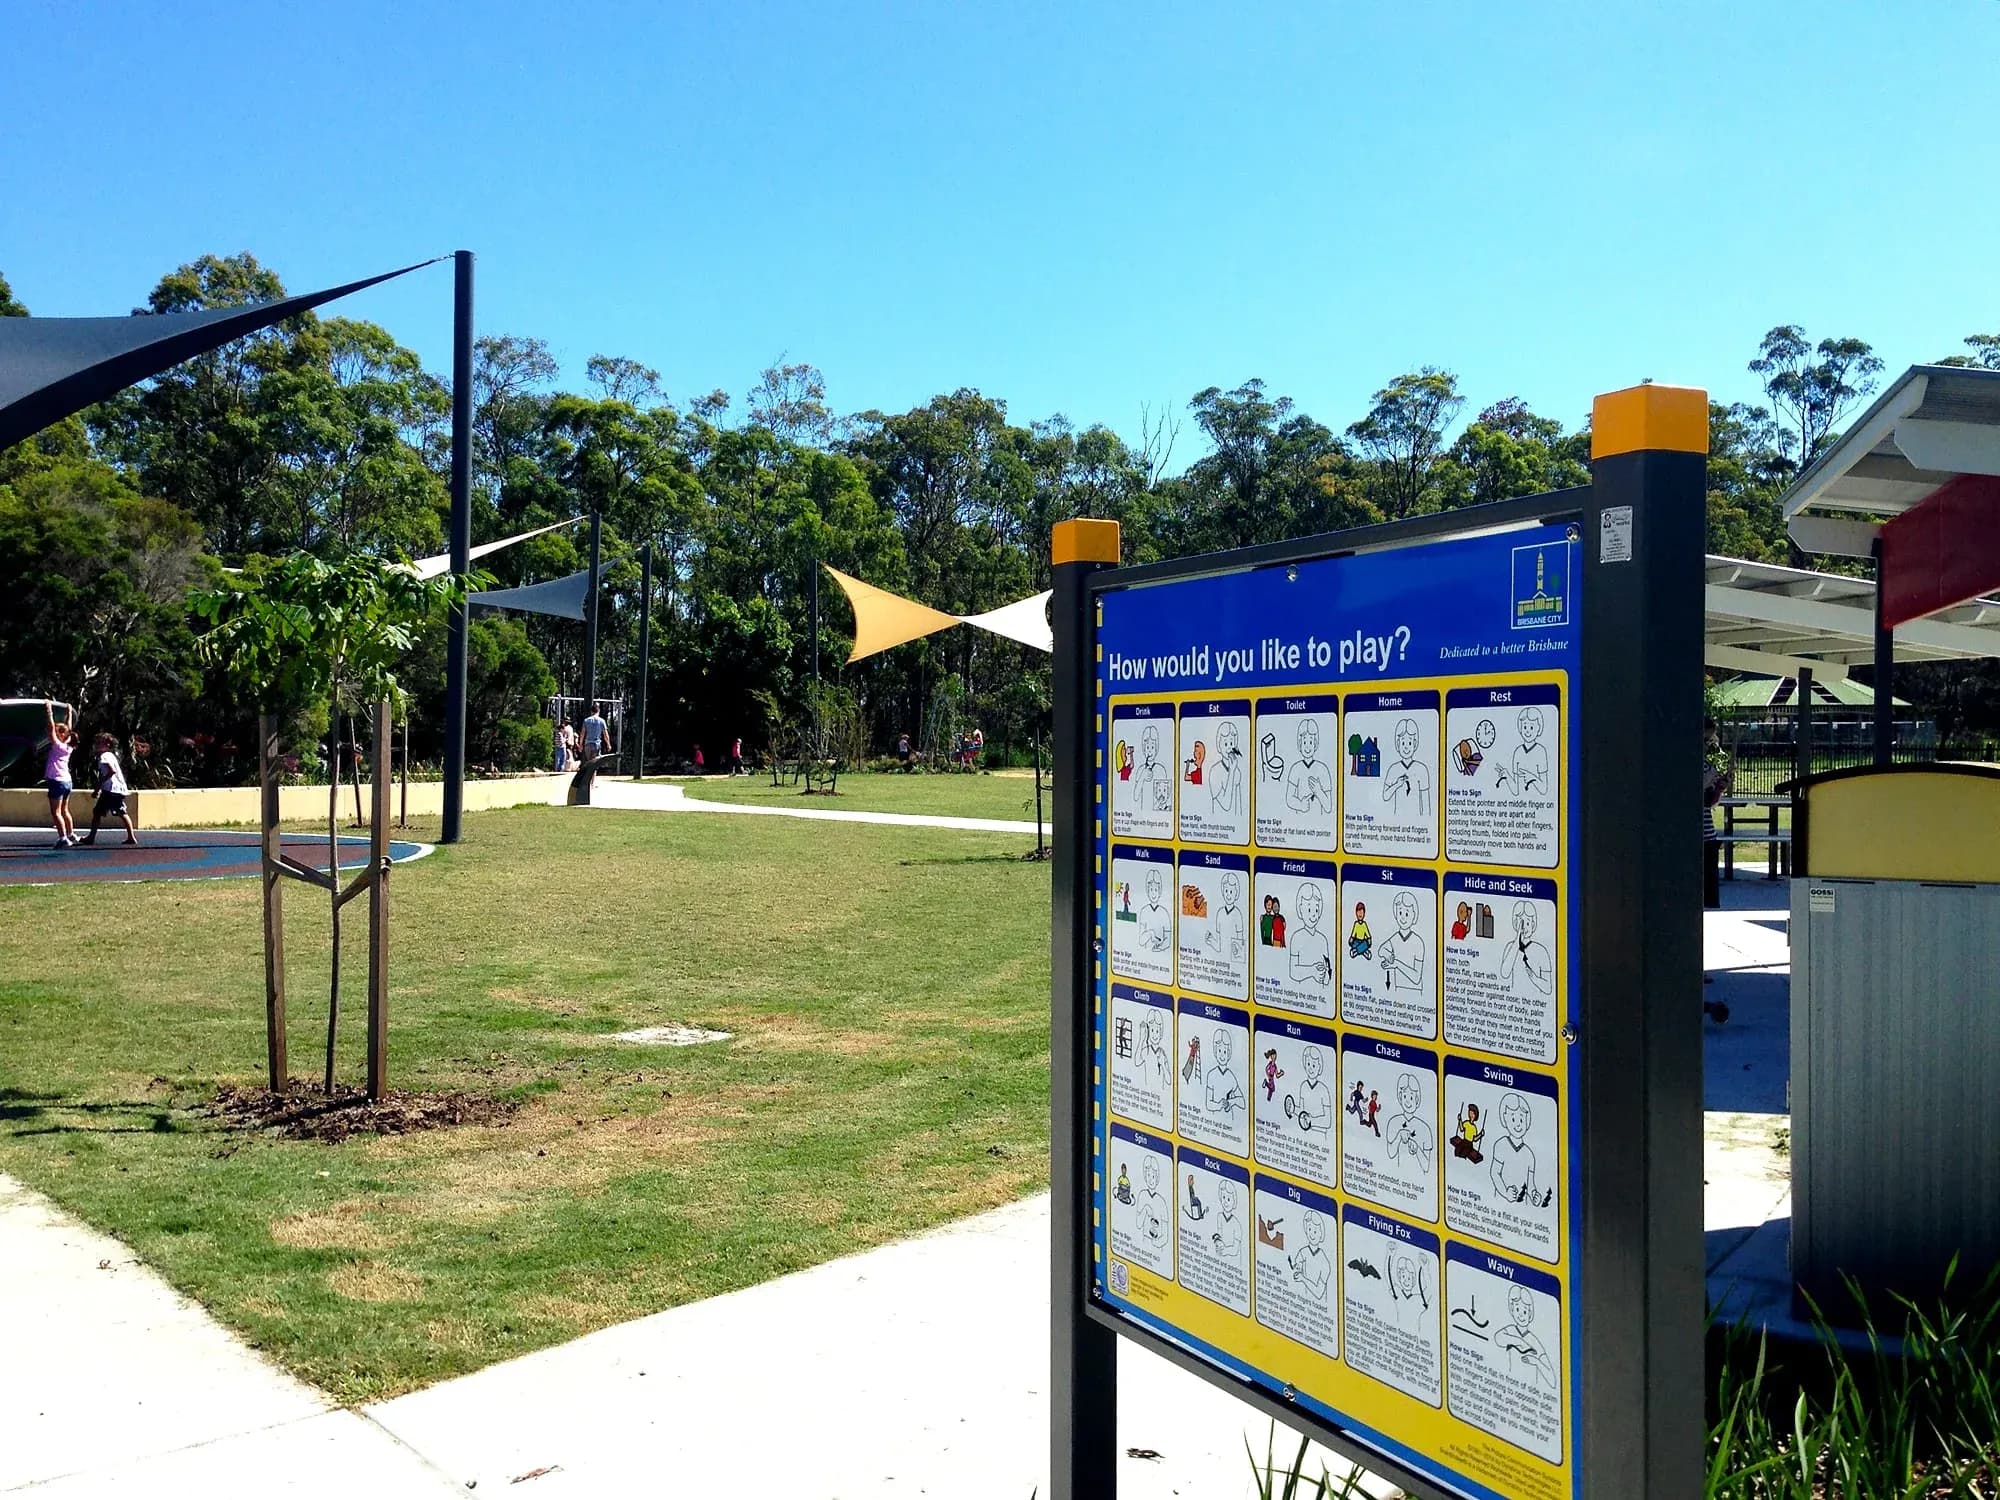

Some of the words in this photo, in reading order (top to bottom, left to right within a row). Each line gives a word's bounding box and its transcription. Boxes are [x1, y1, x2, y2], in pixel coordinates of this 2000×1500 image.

[1548, 614, 1562, 623] CITY
[1110, 653, 1147, 681] How
[1152, 645, 1209, 677] would
[1215, 649, 1254, 682] you
[1262, 638, 1300, 670] like
[1307, 636, 1331, 667] to
[1339, 626, 1411, 673] play?
[1440, 645, 1479, 660] Dedicated
[1482, 644, 1490, 656] to
[1493, 647, 1498, 655] a
[1500, 642, 1525, 654] better
[1528, 638, 1568, 652] Brisbane
[1379, 697, 1402, 706] Home
[1491, 692, 1511, 702] Rest
[1209, 704, 1219, 713] Eat
[1286, 700, 1305, 710] Toilet
[1136, 707, 1150, 715] Drink
[1469, 789, 1482, 798] Sign
[1528, 800, 1545, 810] finger
[1485, 809, 1497, 818] they
[1363, 815, 1374, 823] Sign
[1136, 849, 1149, 858] Walk
[1206, 855, 1220, 864] Sand
[1283, 862, 1305, 872] Friend
[1382, 870, 1392, 880] Sit
[1465, 877, 1486, 889] Hide
[1489, 880, 1505, 890] and
[1509, 881, 1532, 893] Seek
[1467, 949, 1479, 958] Sign
[1205, 1006, 1220, 1017] Slide
[1287, 1024, 1300, 1035] Run
[1376, 1044, 1400, 1058] Chase
[1484, 1067, 1513, 1086] Swing
[1135, 1133, 1147, 1144] Spin
[1205, 1158, 1220, 1171] Rock
[1289, 1187, 1300, 1202] Dig
[1448, 1185, 1460, 1194] How
[1468, 1191, 1481, 1201] Sign
[1369, 1216, 1393, 1235] Flying
[1396, 1225, 1410, 1239] Fox
[1488, 1258, 1514, 1278] Wavy
